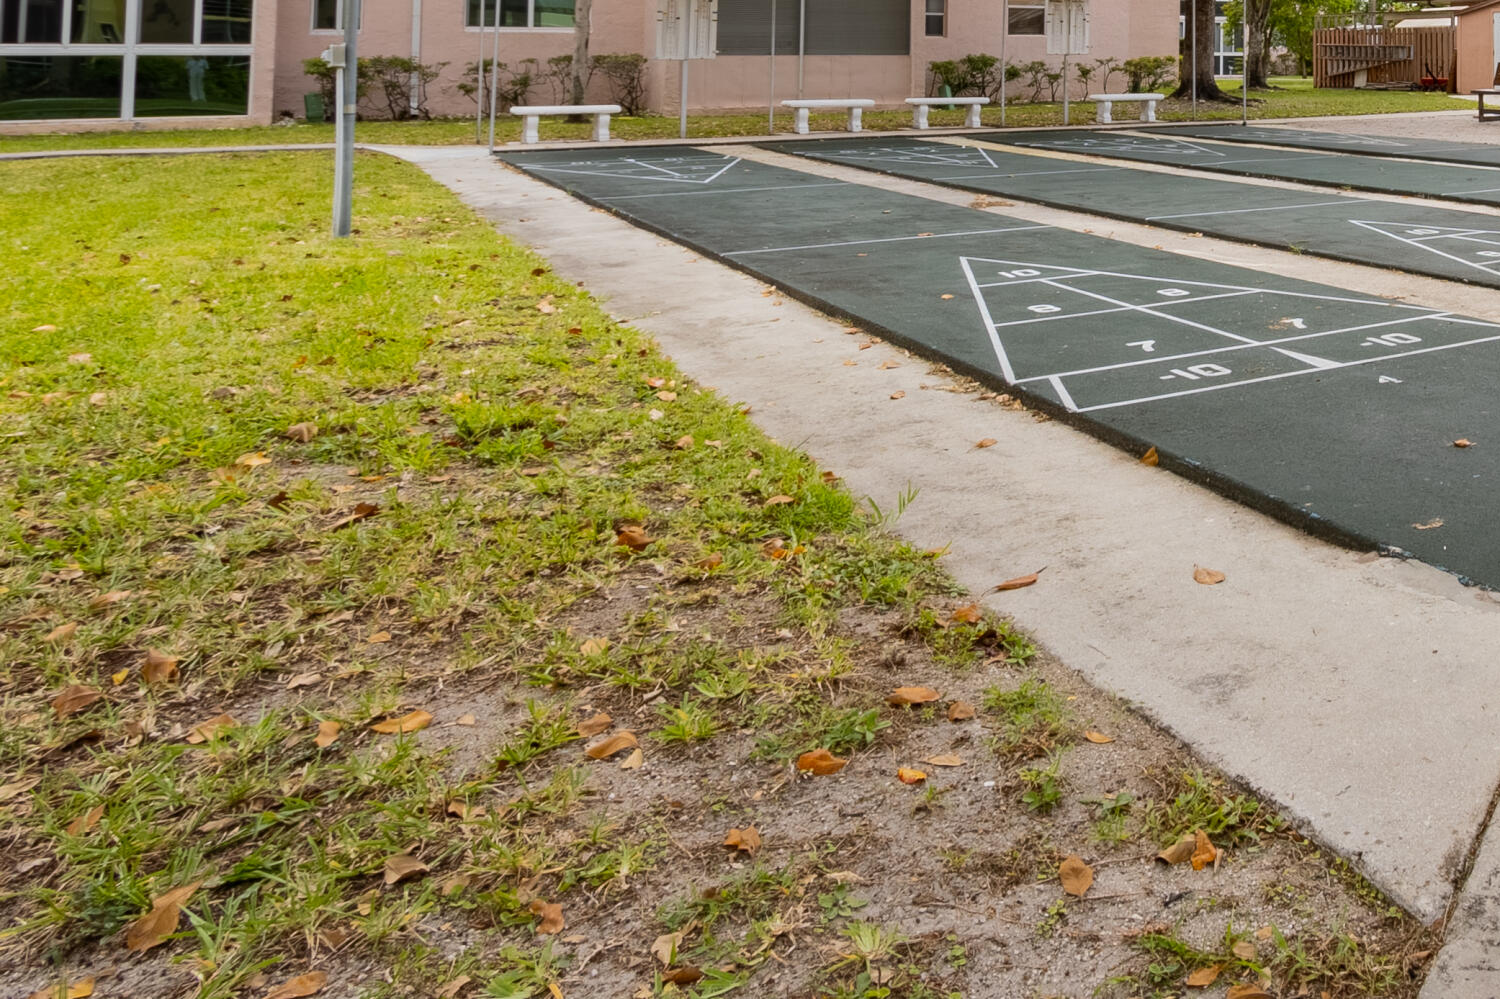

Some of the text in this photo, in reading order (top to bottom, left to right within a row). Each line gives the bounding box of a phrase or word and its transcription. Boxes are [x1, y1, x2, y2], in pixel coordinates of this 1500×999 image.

[998, 269, 1041, 278] 10
[1156, 288, 1191, 297] 8
[1027, 304, 1062, 313] 8
[1280, 317, 1308, 329] 7
[1125, 339, 1156, 352] 7
[1360, 333, 1422, 347] -10
[1159, 363, 1232, 380] -10
